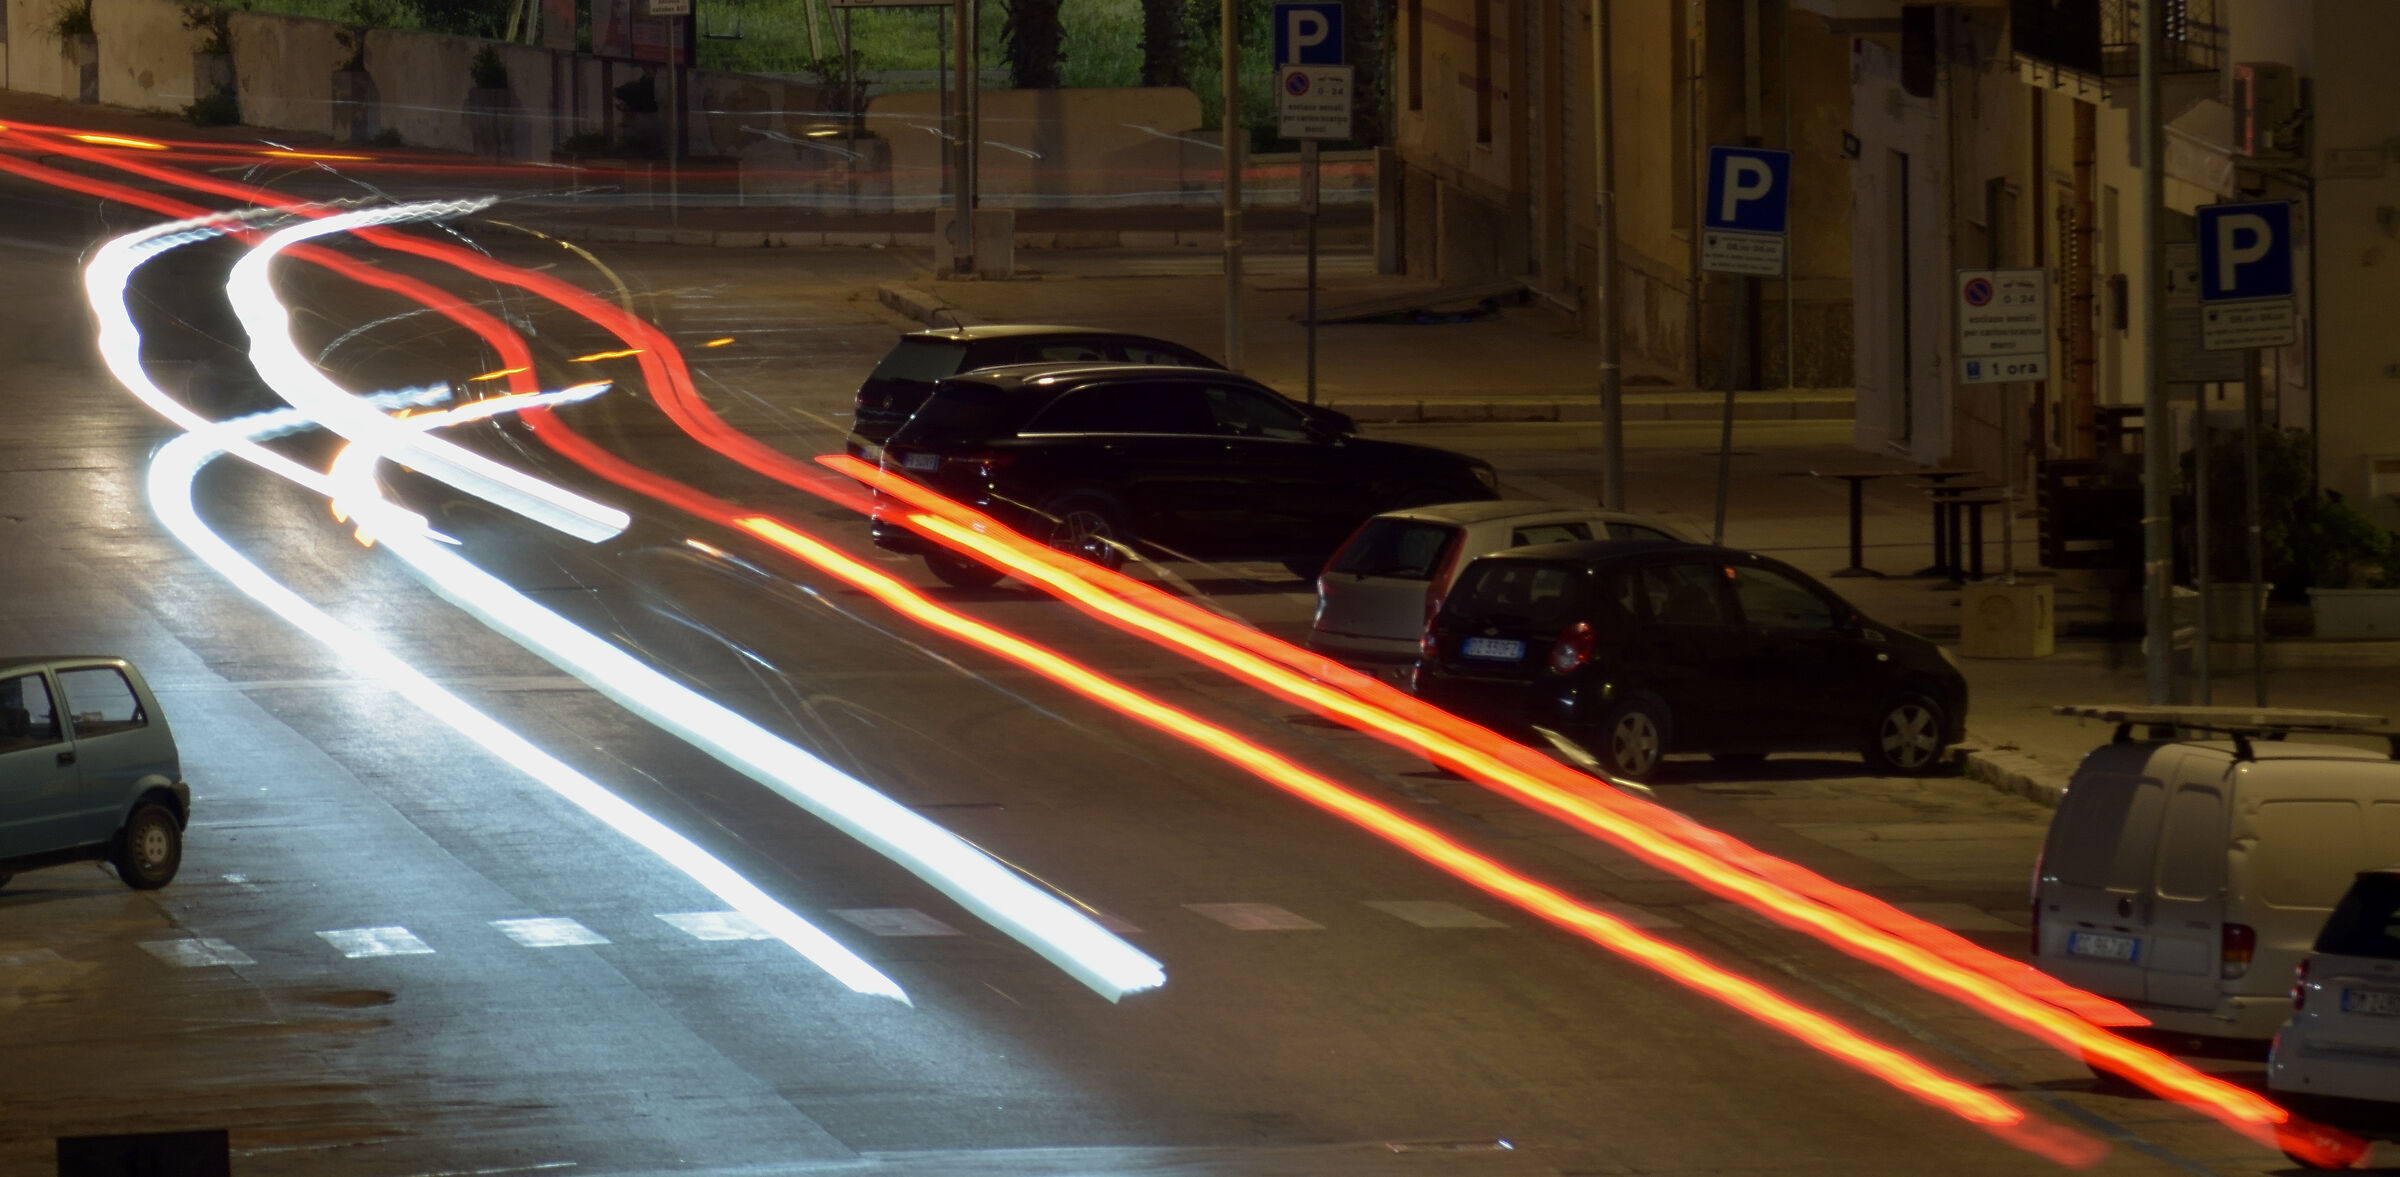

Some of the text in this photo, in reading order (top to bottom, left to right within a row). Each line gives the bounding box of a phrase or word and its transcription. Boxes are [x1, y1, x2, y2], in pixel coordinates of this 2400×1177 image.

[1288, 9, 1329, 64] P
[1720, 155, 1774, 221] P
[2216, 213, 2273, 293] P
[1992, 362, 2038, 375] 1 ora
